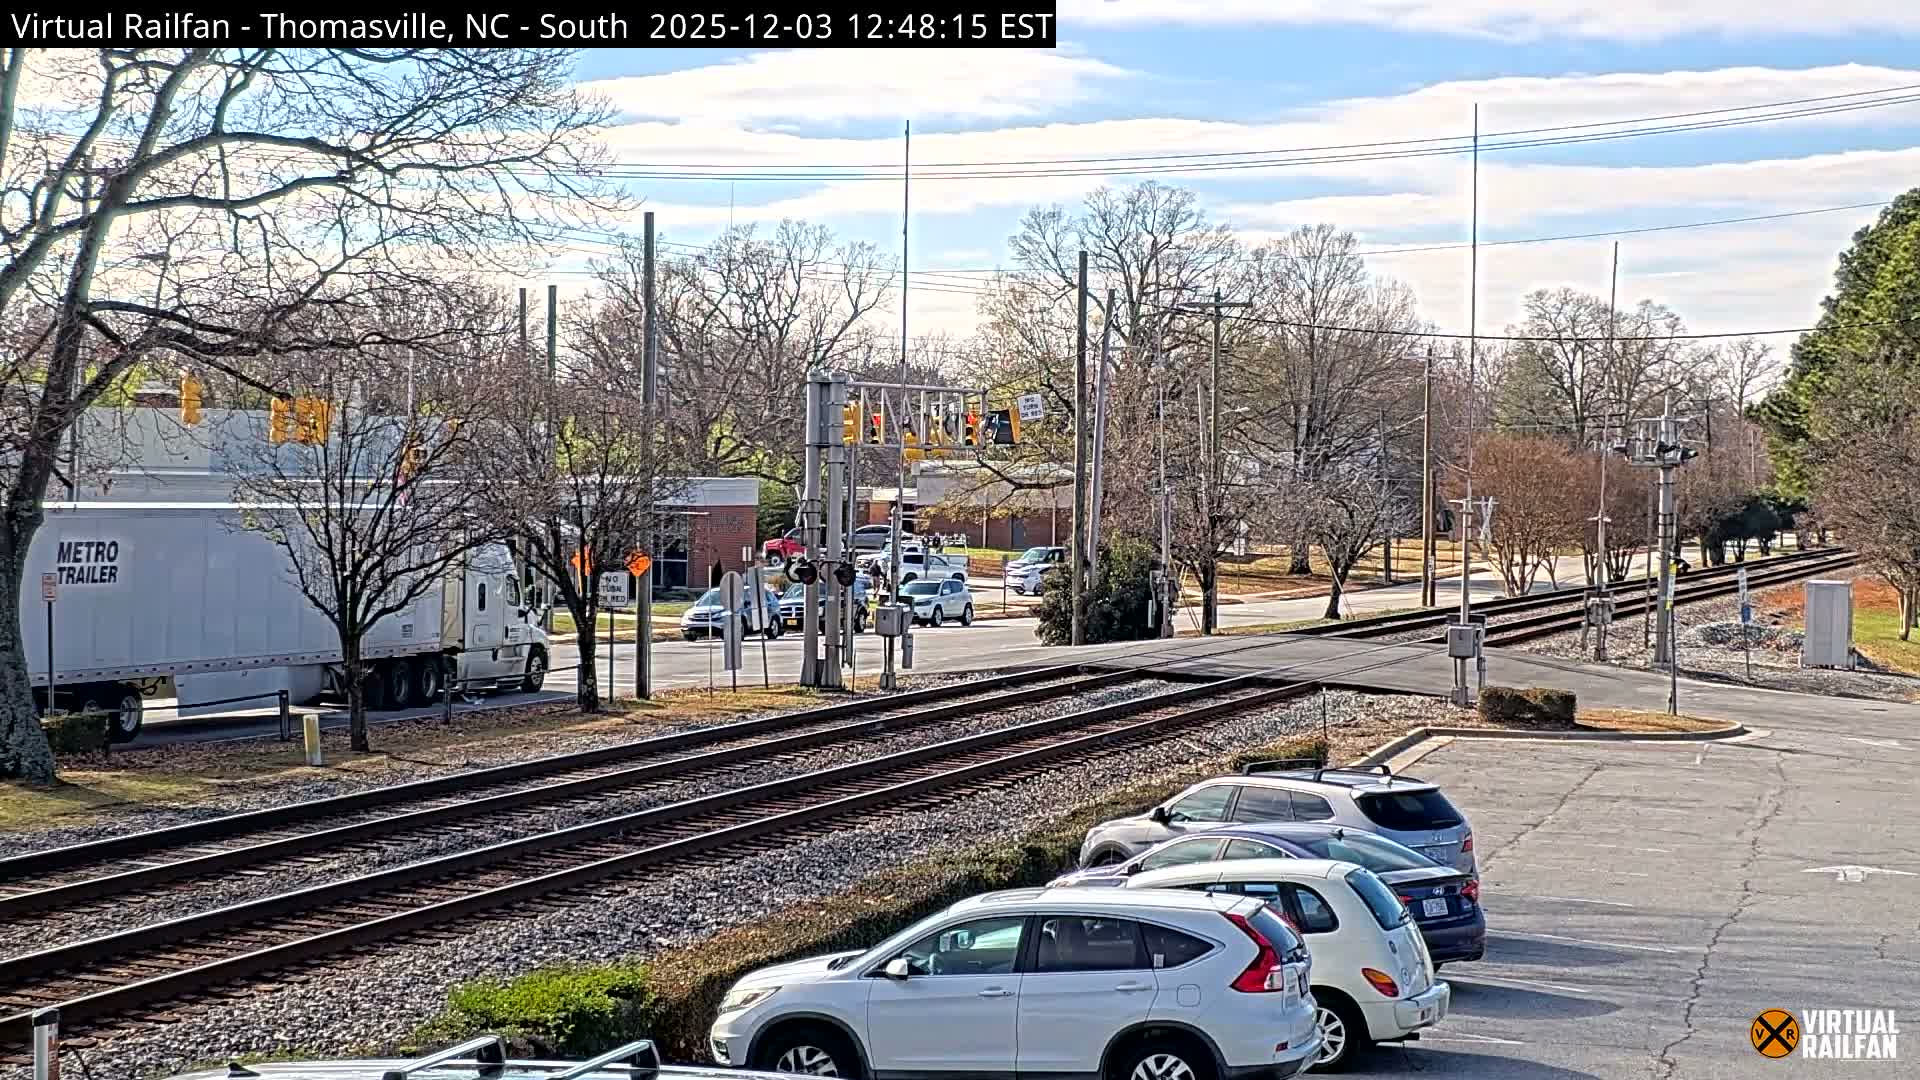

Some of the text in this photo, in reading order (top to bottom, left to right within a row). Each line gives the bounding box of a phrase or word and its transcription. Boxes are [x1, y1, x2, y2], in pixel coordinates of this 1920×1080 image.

[57, 541, 118, 563] METRO
[57, 566, 118, 584] TRAILER
[605, 575, 619, 583] NO
